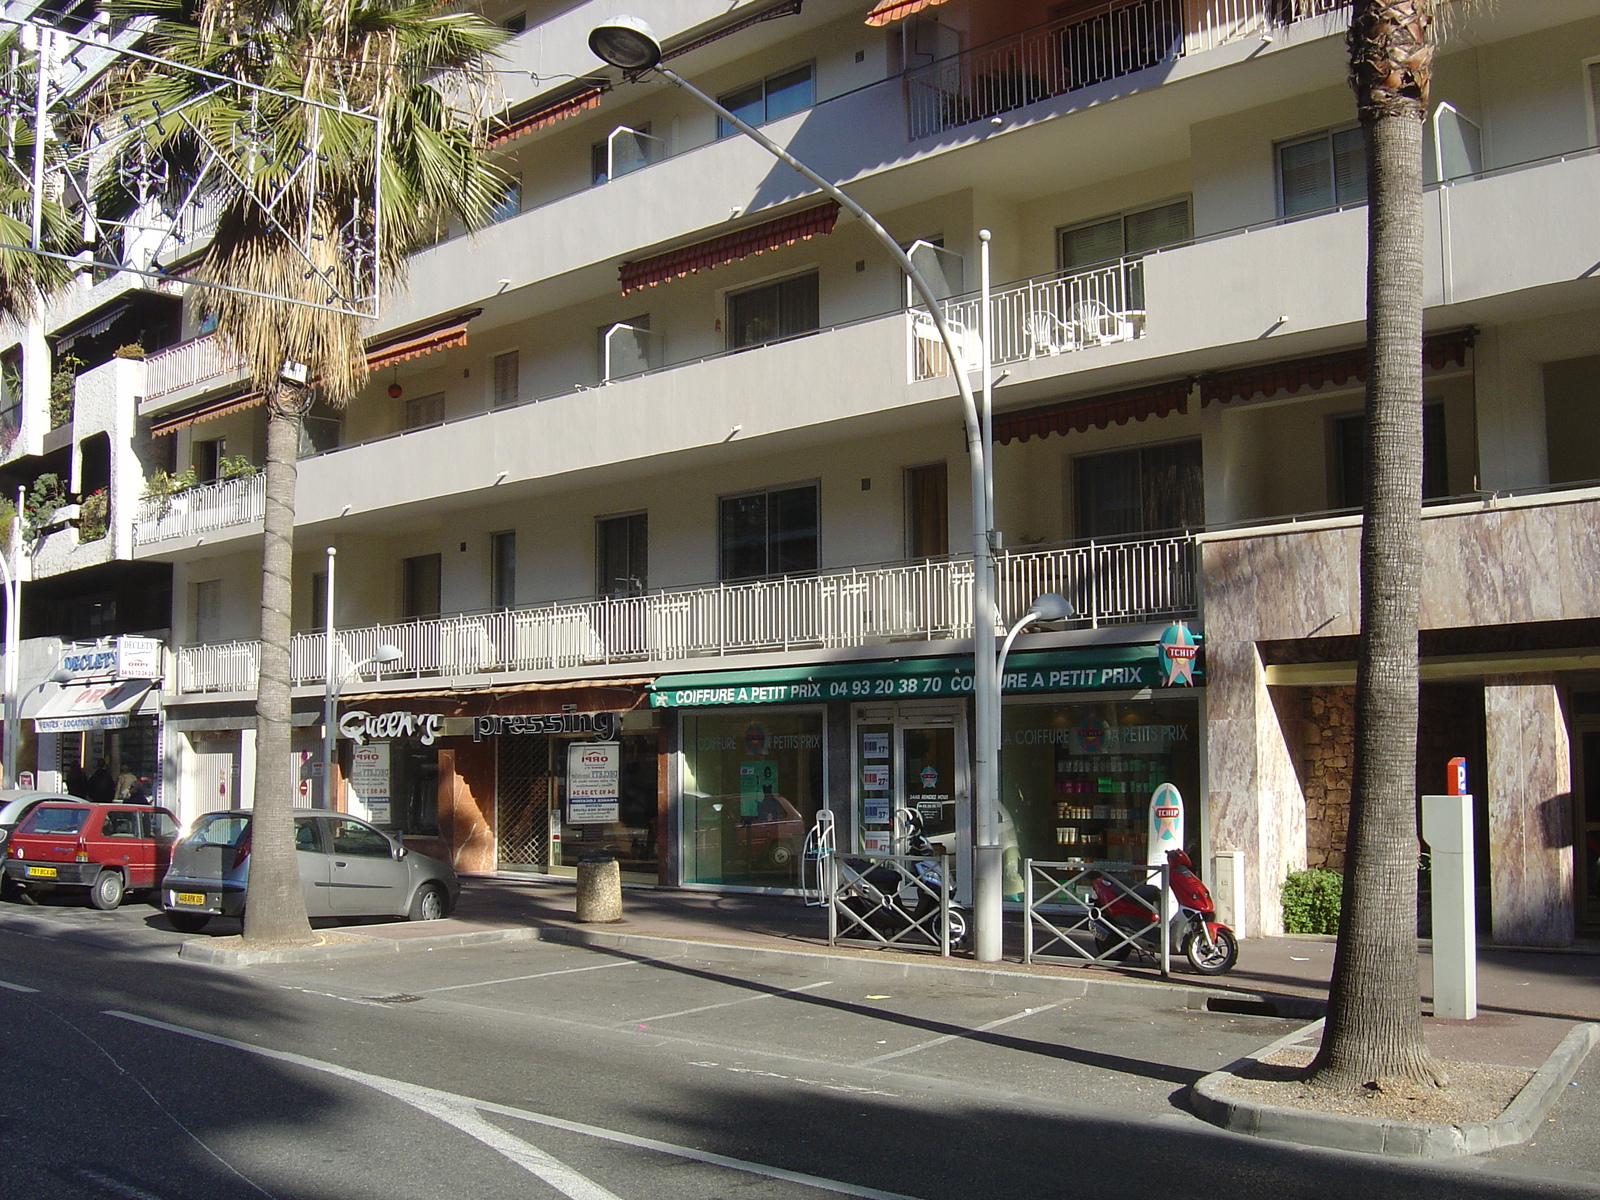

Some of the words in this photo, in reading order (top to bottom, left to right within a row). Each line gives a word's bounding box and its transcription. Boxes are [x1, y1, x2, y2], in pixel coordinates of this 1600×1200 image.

[124, 641, 154, 650] DECLETY
[1170, 648, 1197, 659] TCHIP
[675, 687, 736, 705] COIFFURE
[737, 687, 749, 701] A
[751, 685, 788, 701] PETIT
[790, 683, 822, 699] PRIX
[829, 681, 849, 697] 04
[851, 680, 871, 695] 93
[874, 678, 894, 694] 20
[898, 677, 918, 693] 38
[922, 676, 942, 692] 70
[1031, 671, 1045, 687] A
[1049, 669, 1098, 687] PETIT
[1101, 666, 1143, 684] PRIX
[63, 718, 94, 728] LOCATIONS
[100, 716, 127, 726] GESTION
[339, 710, 444, 746] Queen's
[473, 704, 616, 742] pressing
[1015, 729, 1071, 745] COIFFURE
[1123, 725, 1158, 742] PETITS
[1161, 724, 1189, 741] PRIX
[773, 735, 799, 750] PETITS
[800, 734, 821, 749] PRIX
[1457, 765, 1466, 789] P
[1157, 809, 1179, 817] TCHIP
